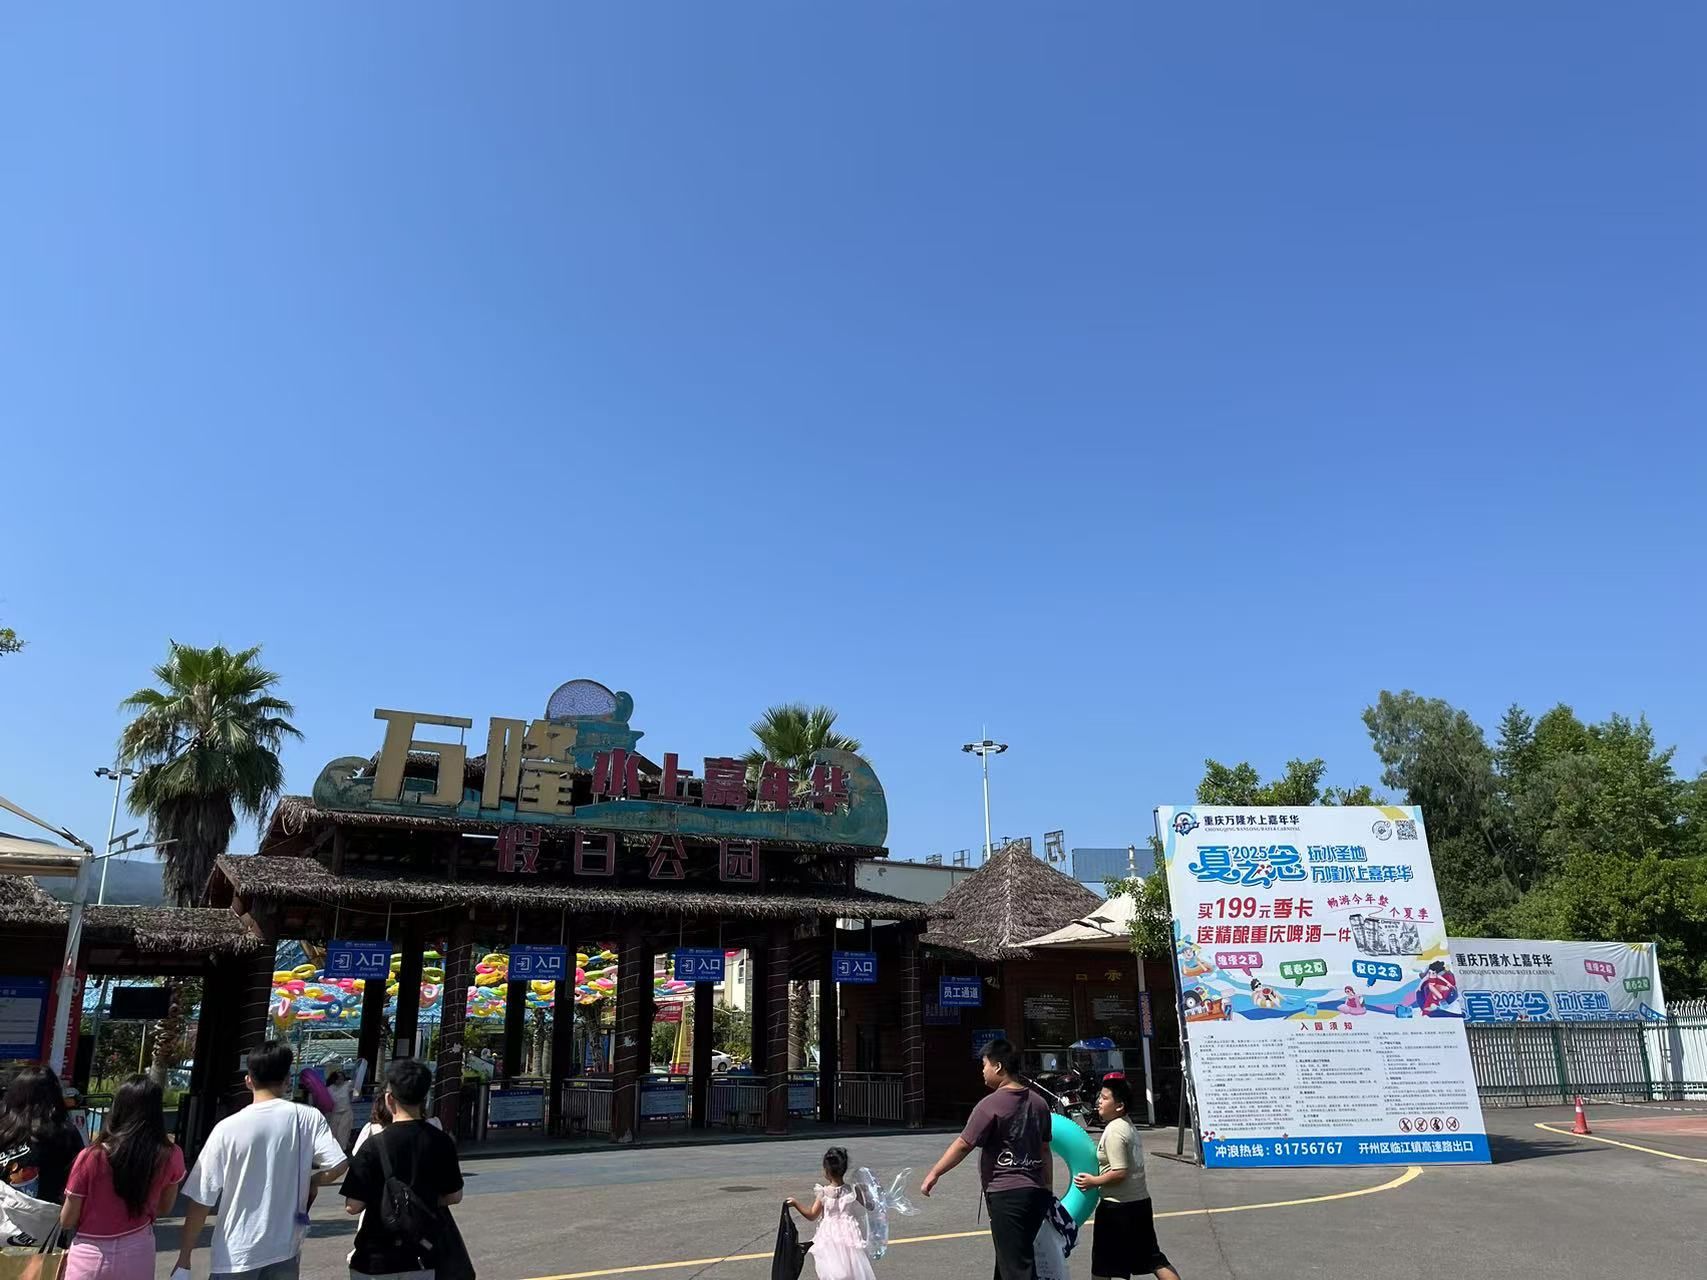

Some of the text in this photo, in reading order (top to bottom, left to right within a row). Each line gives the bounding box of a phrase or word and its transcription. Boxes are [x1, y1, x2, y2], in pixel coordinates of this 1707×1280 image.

[373, 709, 852, 814] 万隆 水上嘉年华
[1204, 814, 1300, 826] 重庆万隆水上嘉年华
[496, 826, 760, 883] 假日公园
[1232, 846, 1267, 859] 2025
[1307, 845, 1368, 861] 玩水圣地
[1311, 865, 1413, 882] 万隆水上嘉年华
[1197, 897, 1313, 919] 买199元季卡
[1197, 924, 1351, 944] 送精酿重庆啤酒一件
[355, 952, 385, 967] 入口
[535, 955, 561, 969] 入口
[698, 958, 721, 971] 入口
[852, 960, 873, 973] 入口
[1456, 953, 1553, 967] 重庆万隆水上嘉年华
[944, 986, 979, 998] 员工通道
[1494, 993, 1524, 1008] 2025
[1555, 993, 1609, 1010] 玩水圣地
[1300, 1022, 1353, 1031] 入园须知
[1359, 1140, 1474, 1155] 开州区临江镇高速路出口
